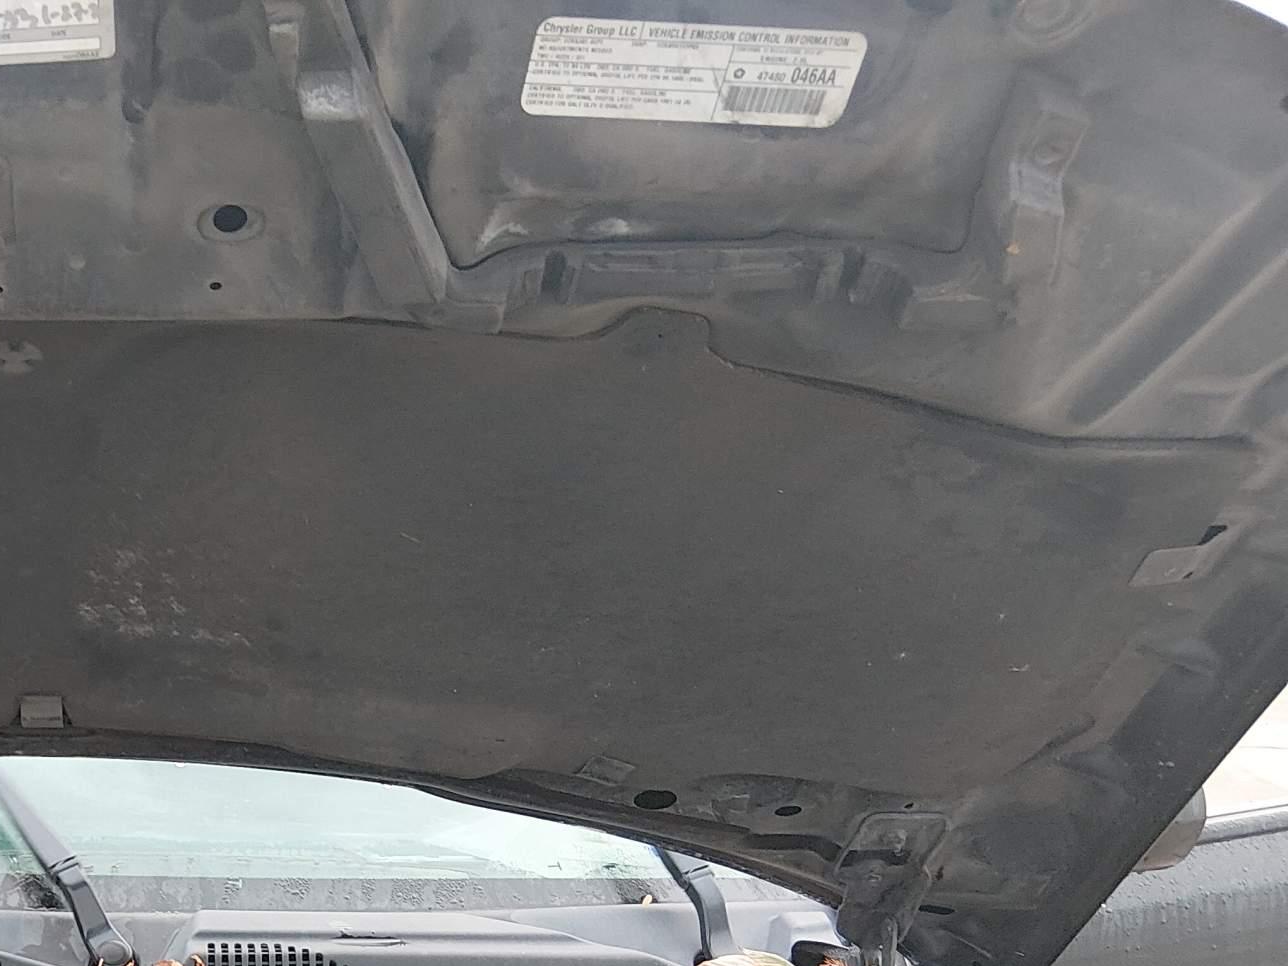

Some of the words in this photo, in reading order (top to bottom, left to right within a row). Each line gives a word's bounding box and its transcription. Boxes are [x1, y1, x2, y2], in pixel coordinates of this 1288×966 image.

[543, 22, 583, 35] Chrysler
[586, 23, 615, 37] Group
[618, 25, 637, 37] LLC
[648, 27, 687, 40] VEHICLE
[689, 30, 737, 42] EMISSION
[738, 31, 781, 44] CONTROL
[784, 34, 851, 47] INFORMATION
[790, 67, 837, 85] 046AA
